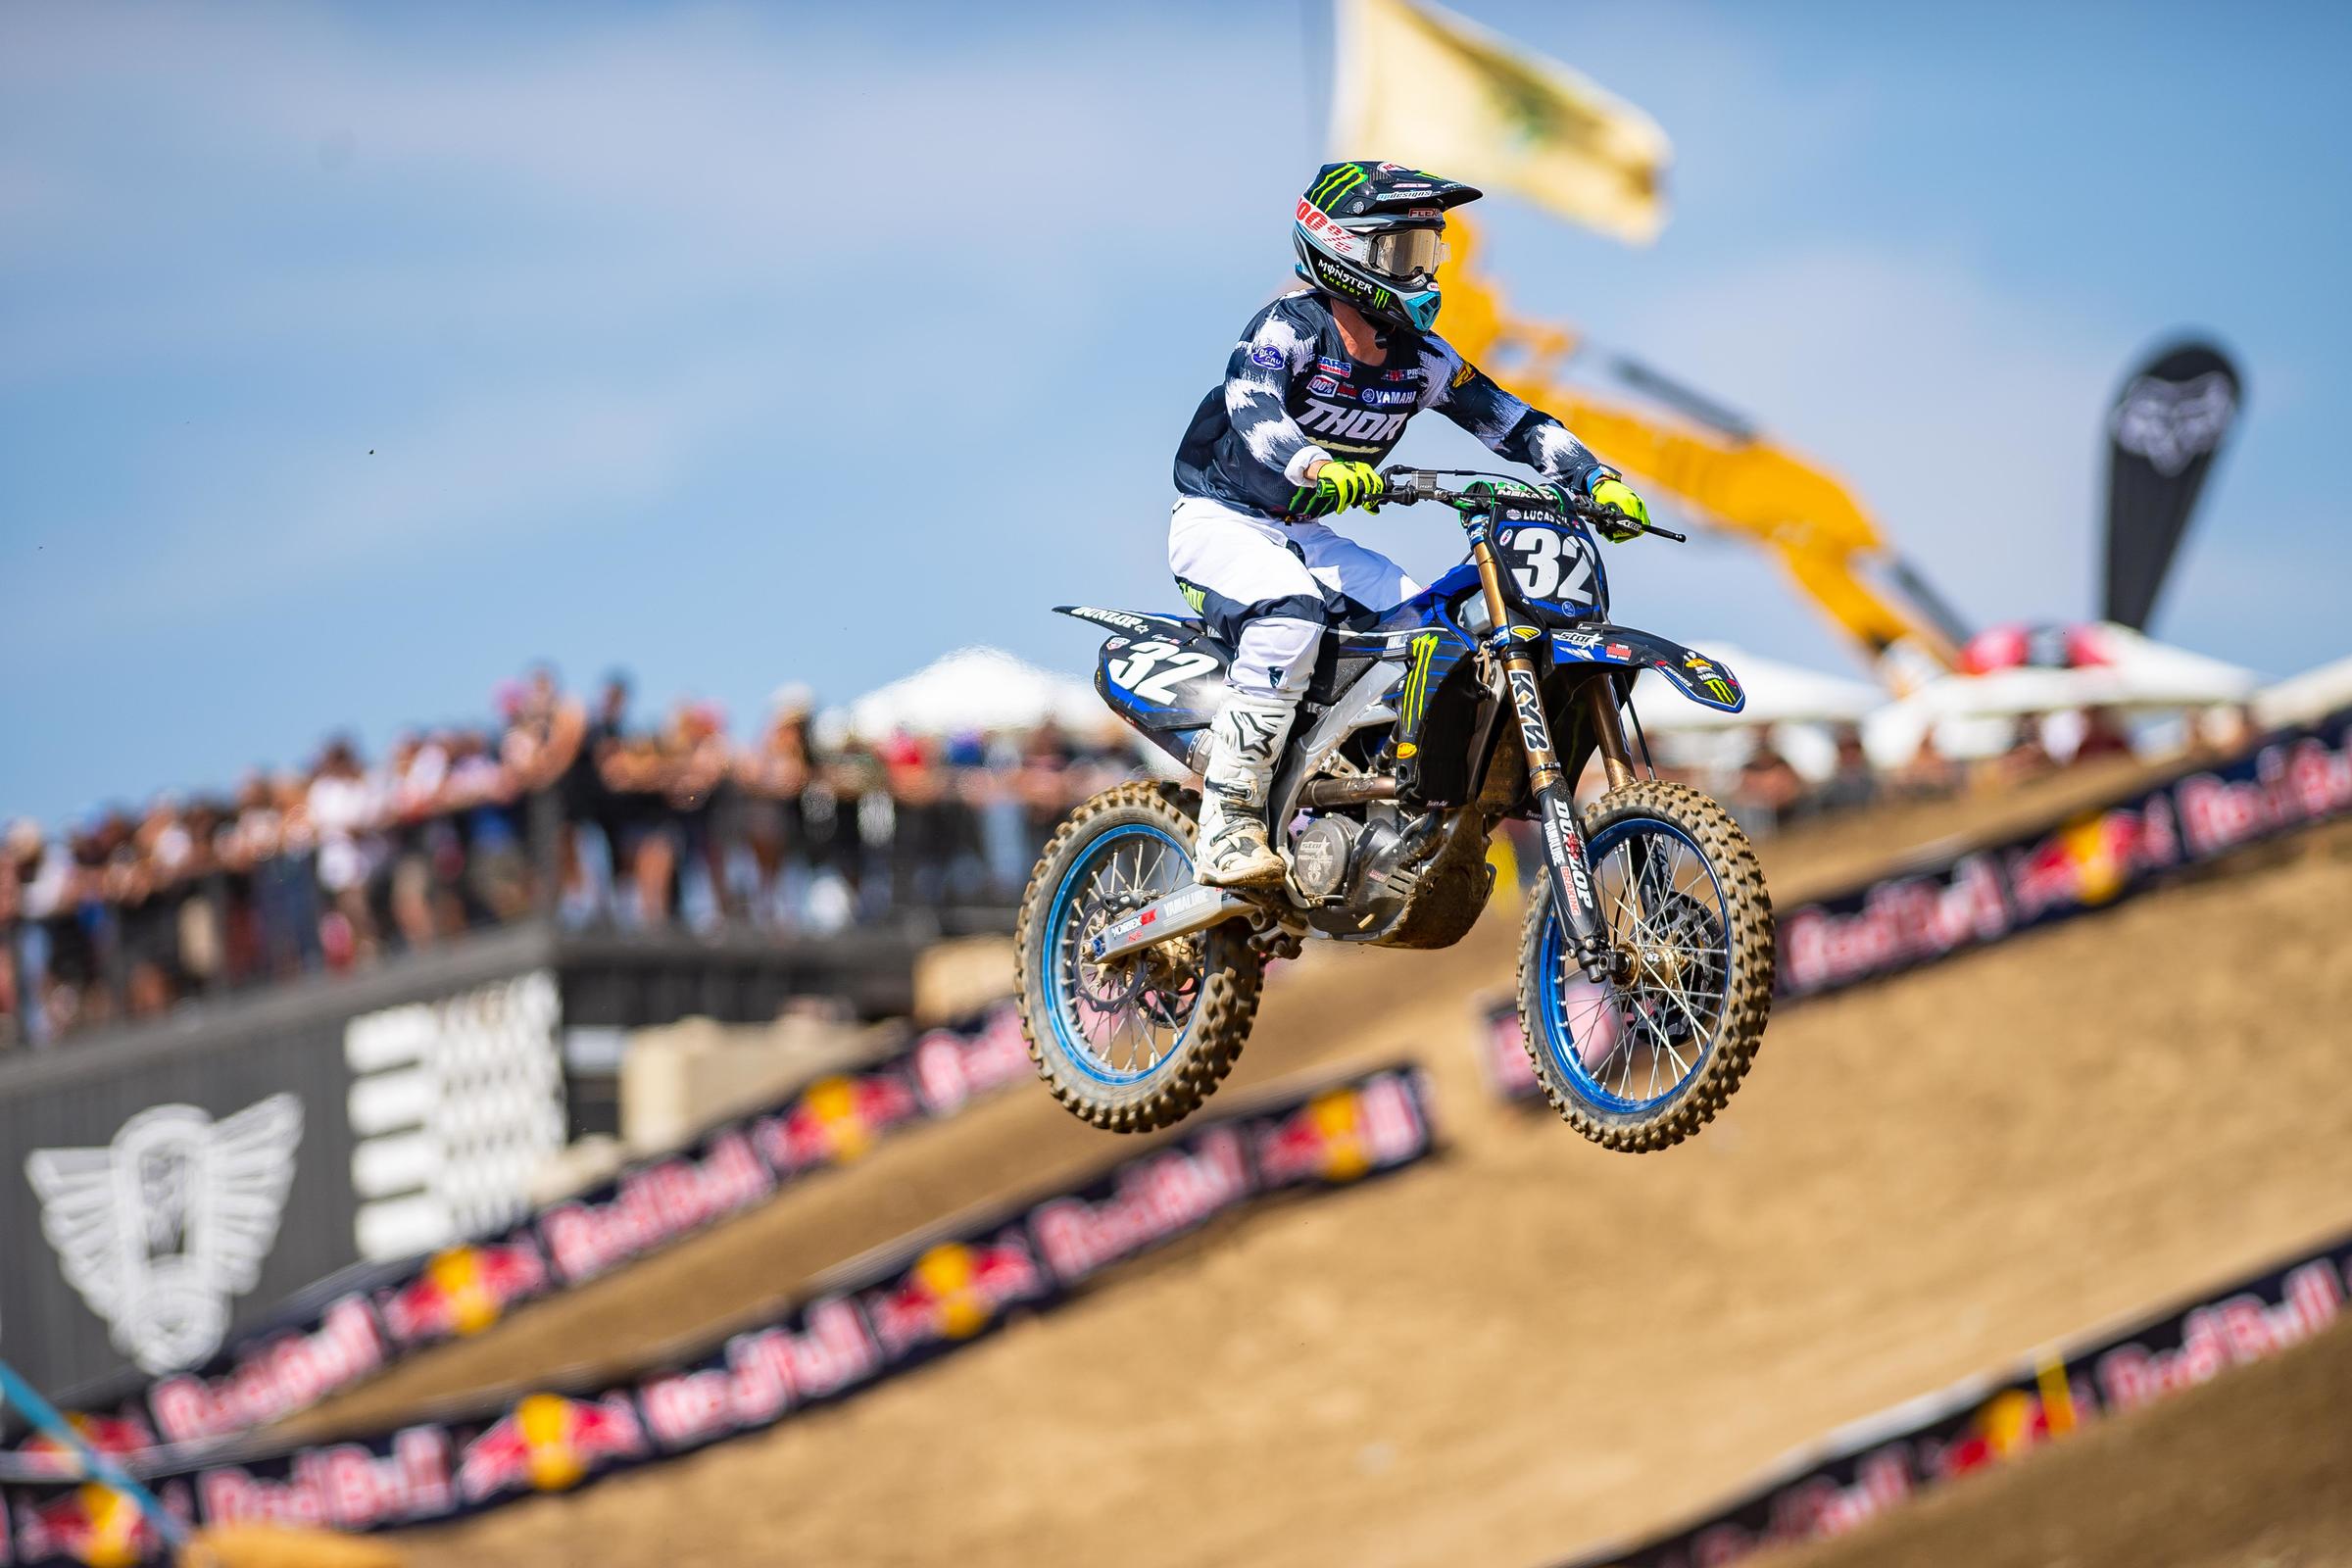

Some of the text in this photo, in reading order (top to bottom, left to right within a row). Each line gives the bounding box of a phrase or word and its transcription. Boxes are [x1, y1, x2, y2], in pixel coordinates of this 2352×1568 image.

[1318, 259, 1373, 295] MONSTER
[1323, 273, 1362, 296] ENERGY
[1296, 398, 1407, 441] THOR
[1375, 390, 1417, 405] YAMAH
[1523, 510, 1554, 523] LUCAS
[1510, 527, 1595, 606] 32
[1071, 607, 1144, 628] DUNLOP
[1107, 641, 1219, 706] 32
[1508, 669, 1550, 753] KYB
[1544, 818, 1566, 867] YAMALUBE
[1553, 799, 1593, 909] DULOP
[1561, 867, 1581, 915] BRAKING
